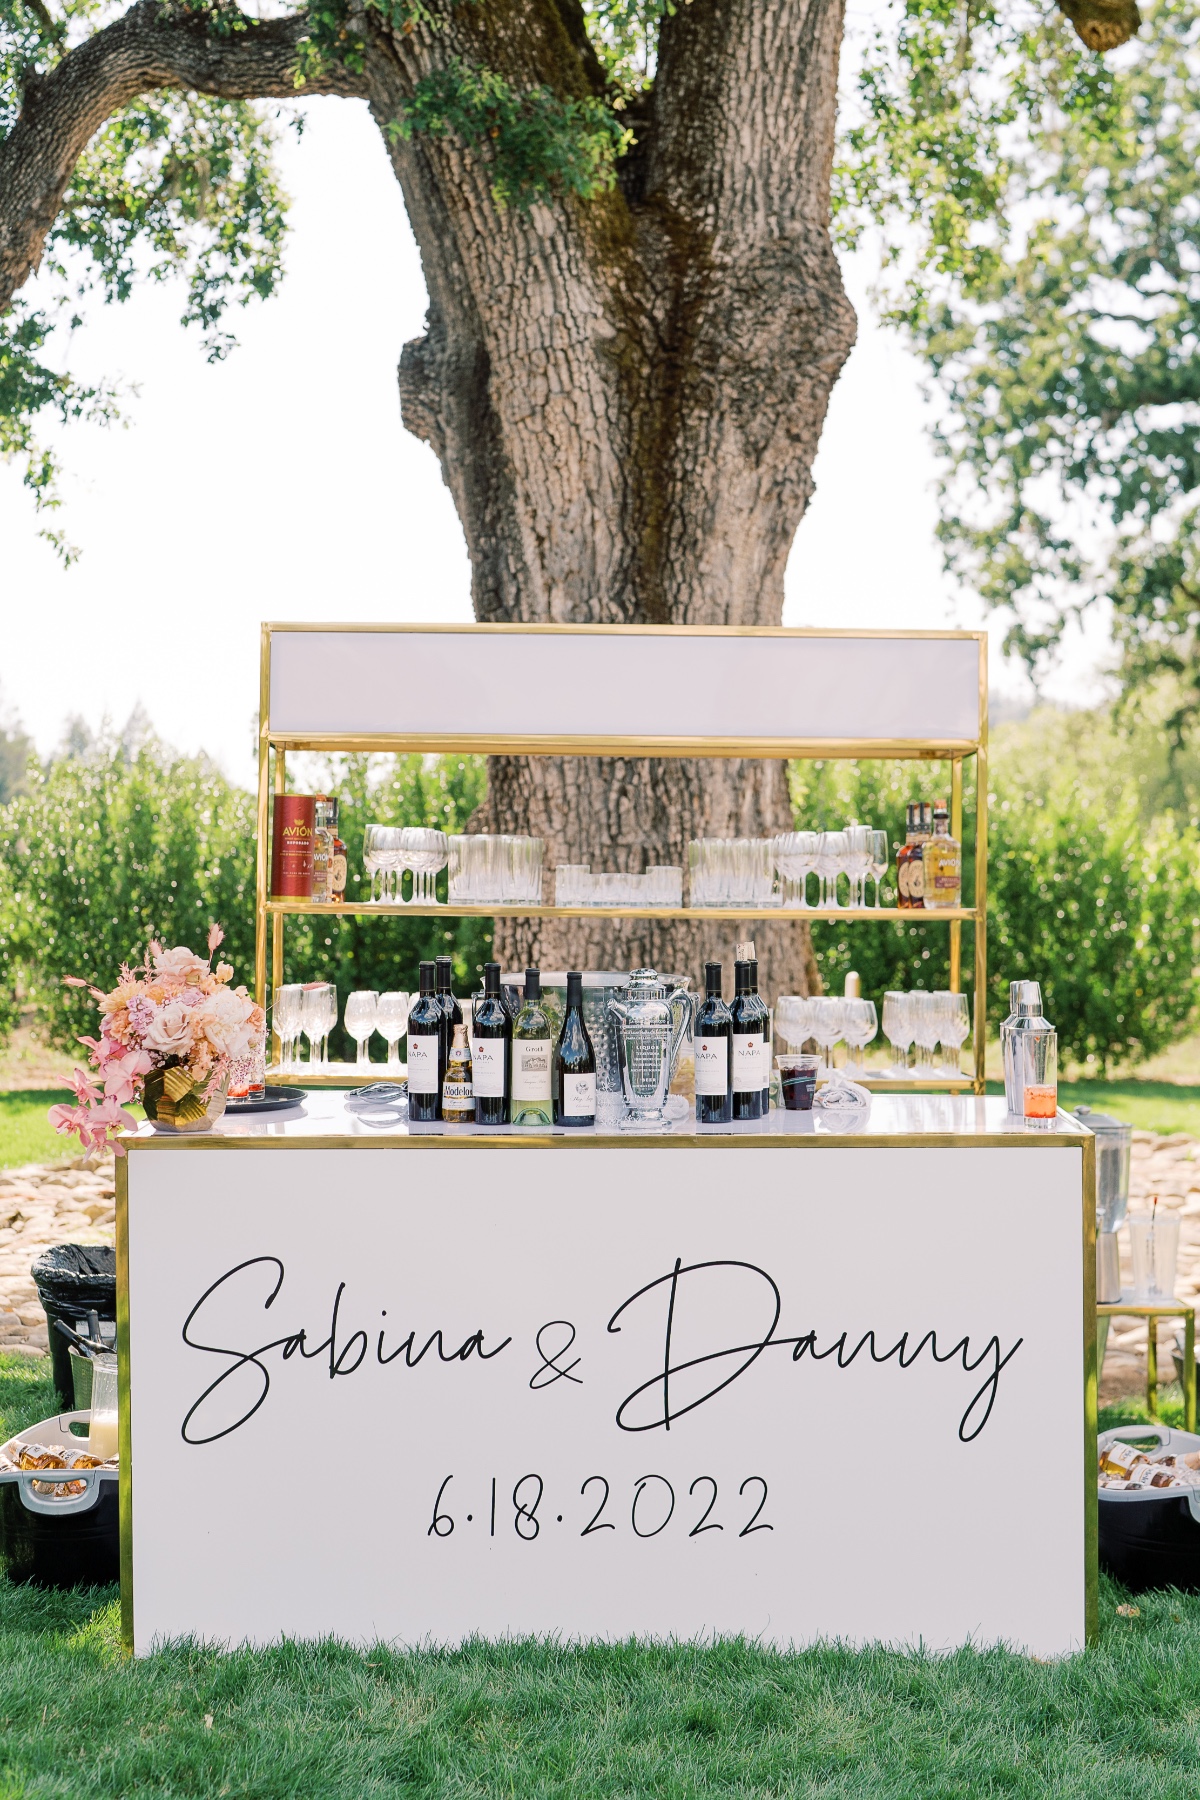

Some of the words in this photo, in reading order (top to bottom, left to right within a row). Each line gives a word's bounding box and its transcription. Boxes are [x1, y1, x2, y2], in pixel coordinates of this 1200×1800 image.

[282, 825, 313, 836] AVIÓN
[738, 1049, 762, 1057] NAPA
[181, 1256, 514, 1445] Sabina
[529, 1320, 585, 1390] &
[606, 1257, 1024, 1443] Danny
[427, 1473, 775, 1541] 6.18.2022
